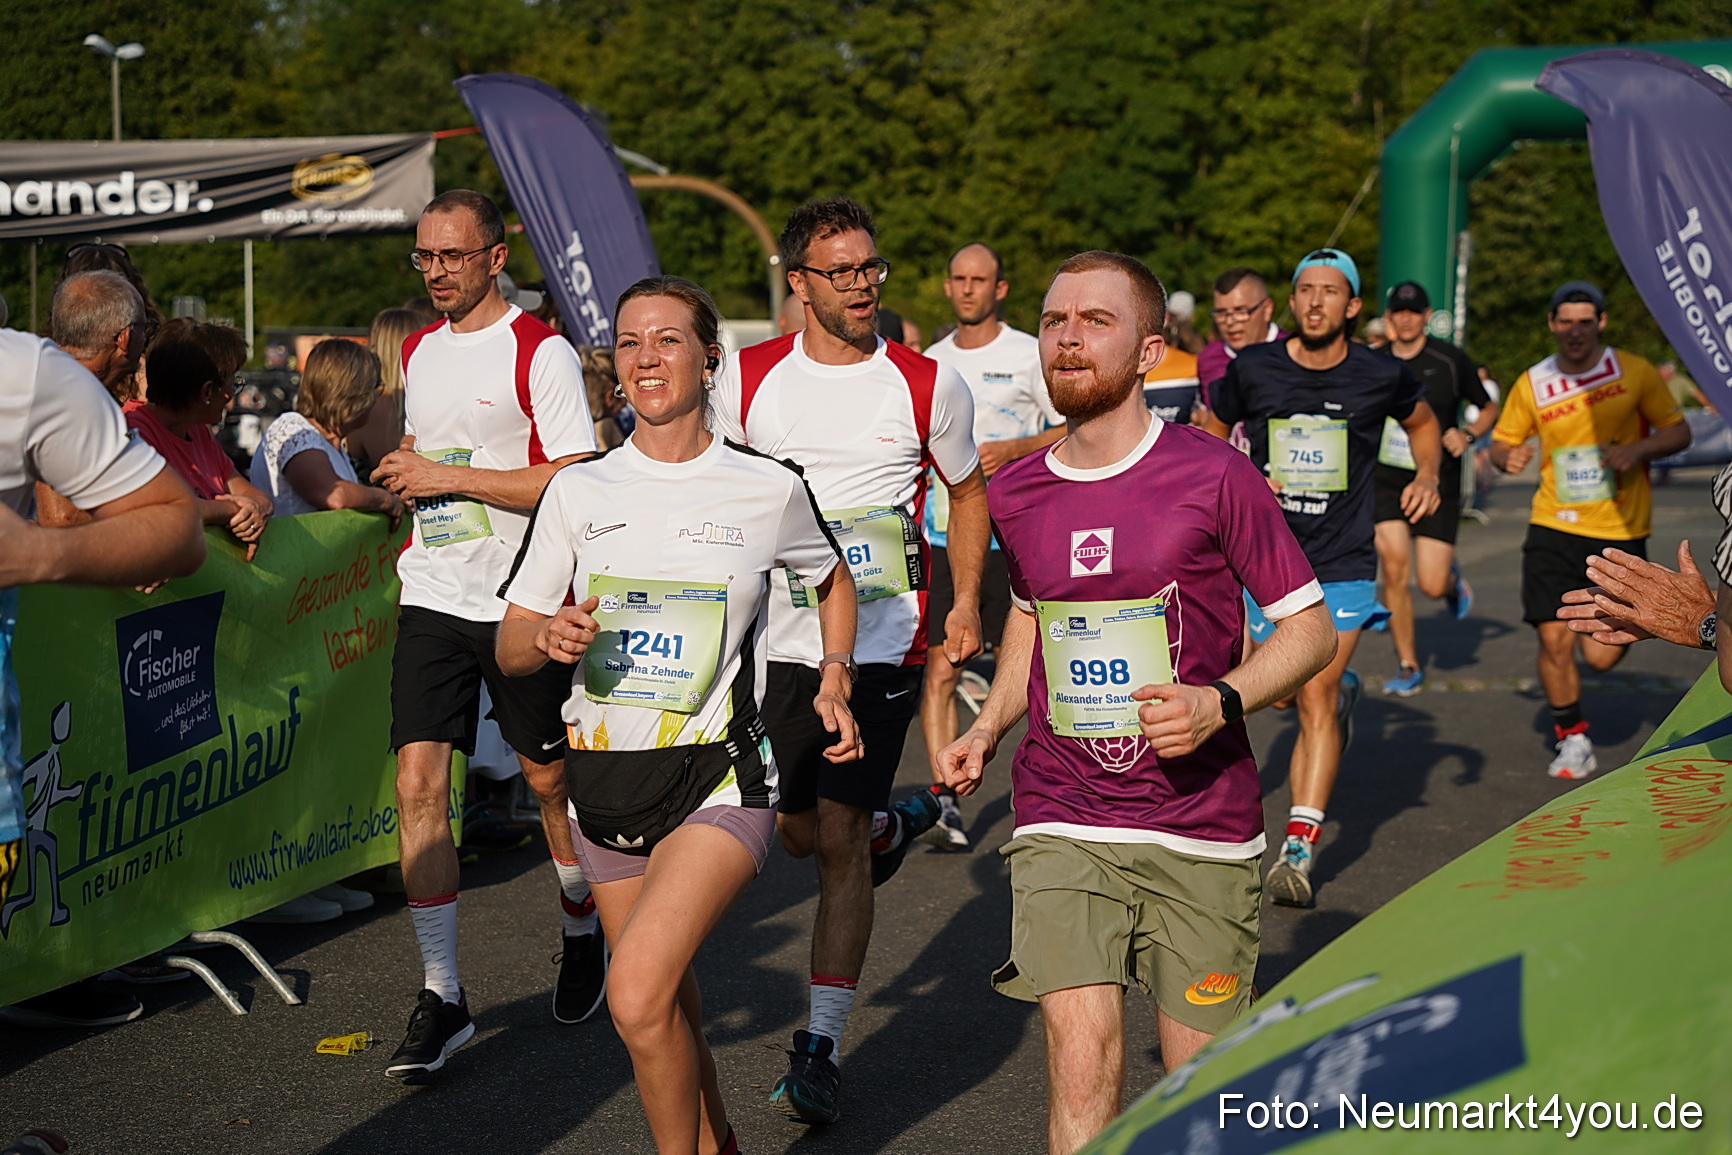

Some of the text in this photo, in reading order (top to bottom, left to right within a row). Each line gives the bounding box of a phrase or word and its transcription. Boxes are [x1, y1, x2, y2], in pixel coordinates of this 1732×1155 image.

[1540, 403, 1577, 422] MAX
[1289, 450, 1323, 464] 745
[438, 512, 463, 522] Meyer
[706, 527, 745, 543] JURA
[840, 543, 872, 566] 61
[1073, 547, 1110, 558] FUCHS
[863, 567, 883, 577] Götz
[324, 606, 388, 673] laufen
[1065, 628, 1101, 637] Firmenlauf
[619, 629, 683, 660] 1241
[138, 644, 201, 686] Fischer
[605, 660, 695, 679] Sabrina Zehnder
[1069, 658, 1130, 686] 998
[147, 671, 196, 701] AUTOMOBILE
[1056, 692, 1102, 704] Alexander
[175, 702, 186, 717] das
[79, 685, 301, 867] firmenlauf
[82, 829, 185, 906] neumarkt
[1198, 972, 1241, 995] RUN
